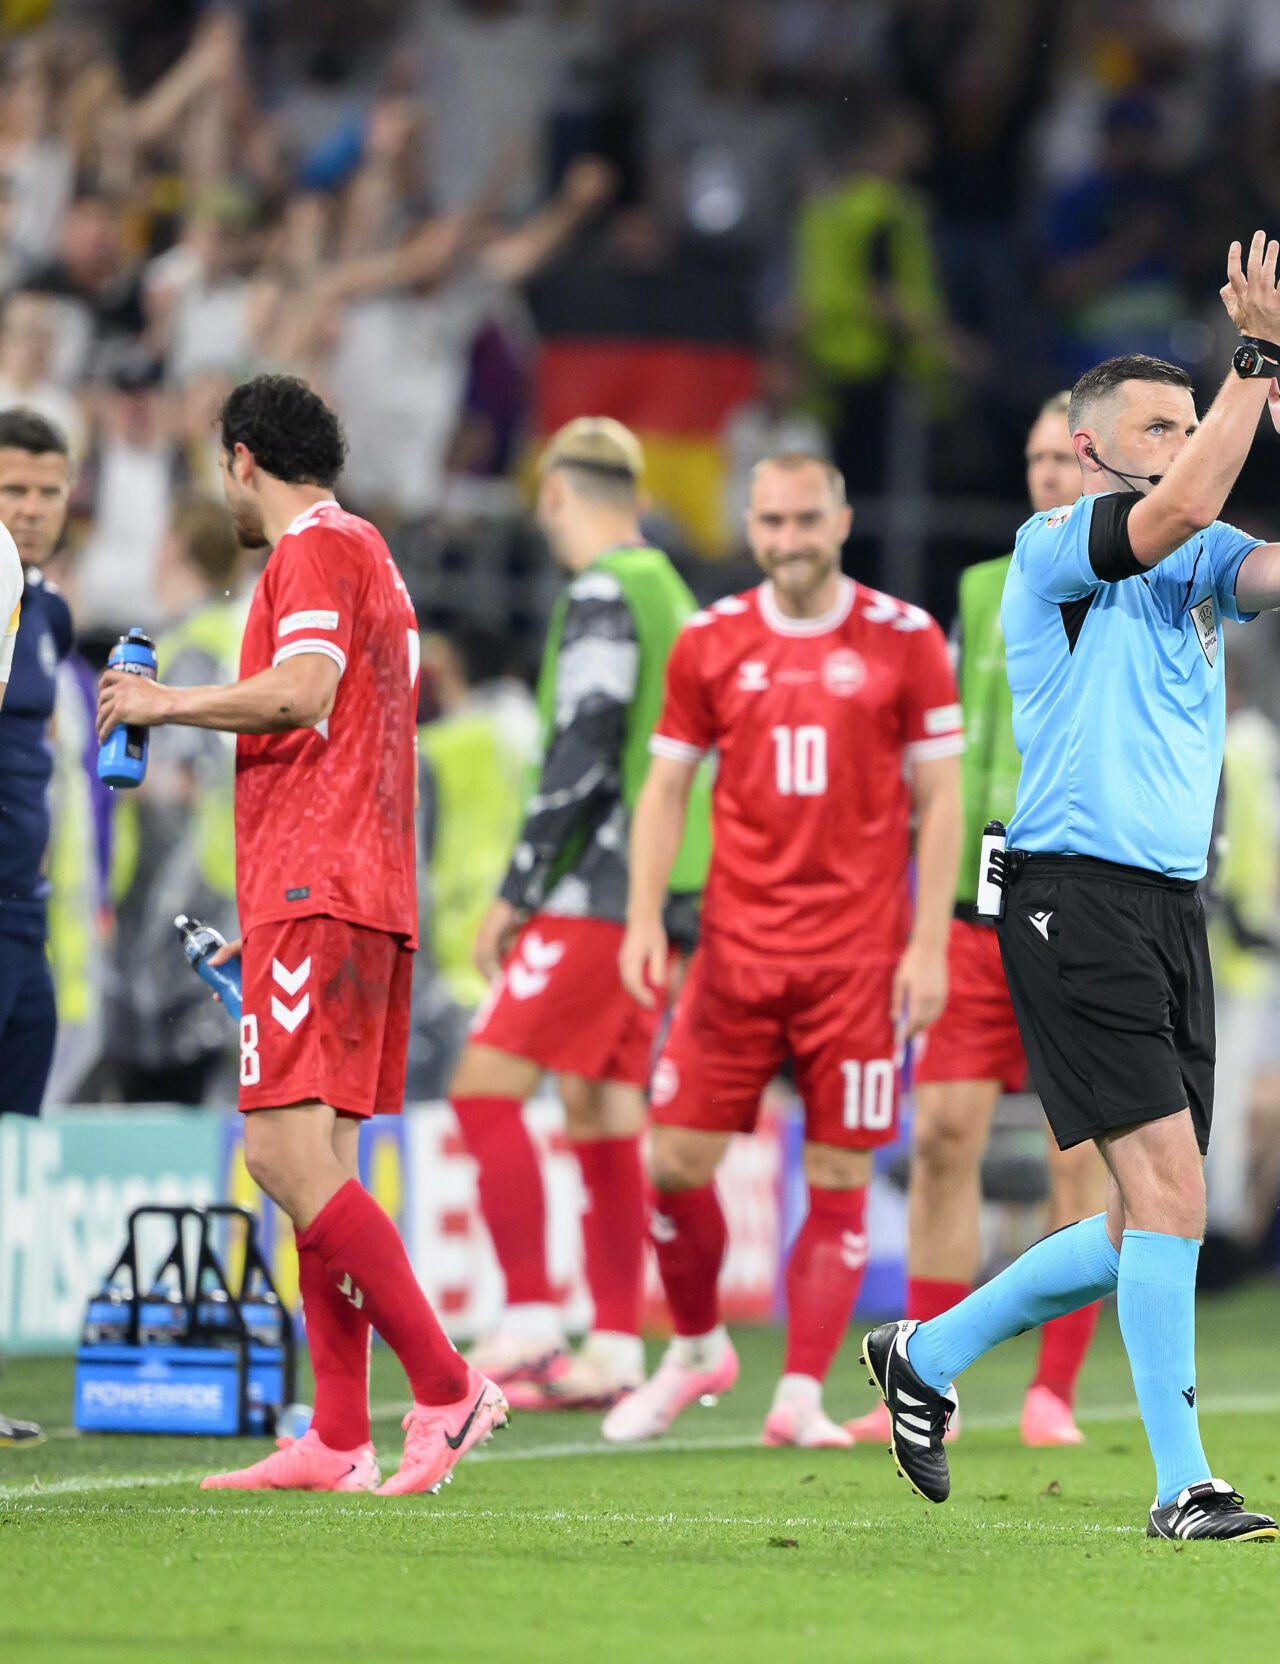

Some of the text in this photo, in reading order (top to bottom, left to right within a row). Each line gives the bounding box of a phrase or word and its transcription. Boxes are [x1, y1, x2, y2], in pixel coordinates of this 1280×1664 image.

[772, 725, 827, 795] 10
[240, 1013, 260, 1087] 8
[841, 1058, 894, 1130] 10
